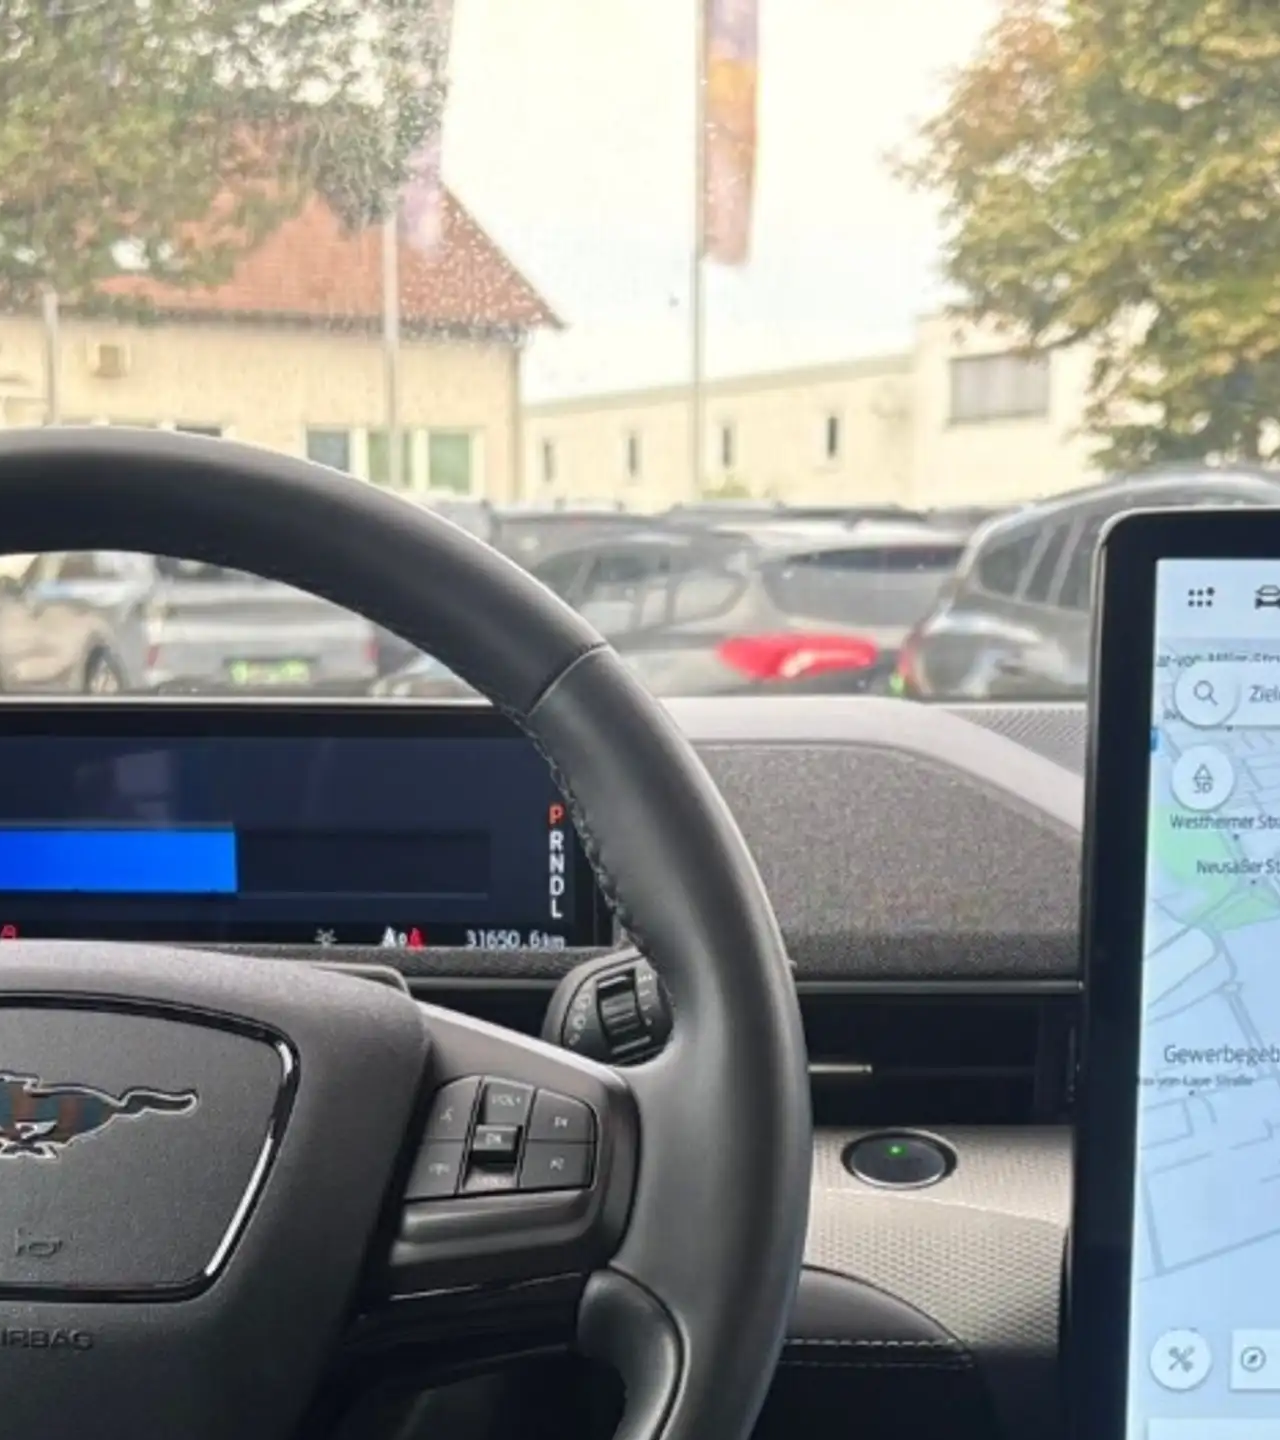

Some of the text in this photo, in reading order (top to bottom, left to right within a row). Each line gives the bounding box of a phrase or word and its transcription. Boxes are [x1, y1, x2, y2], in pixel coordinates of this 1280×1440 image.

[548, 803, 565, 824] P
[1170, 814, 1254, 829] Westheimer
[548, 829, 565, 850] R
[548, 854, 565, 873] N
[548, 876, 565, 896] D
[549, 898, 563, 918] L
